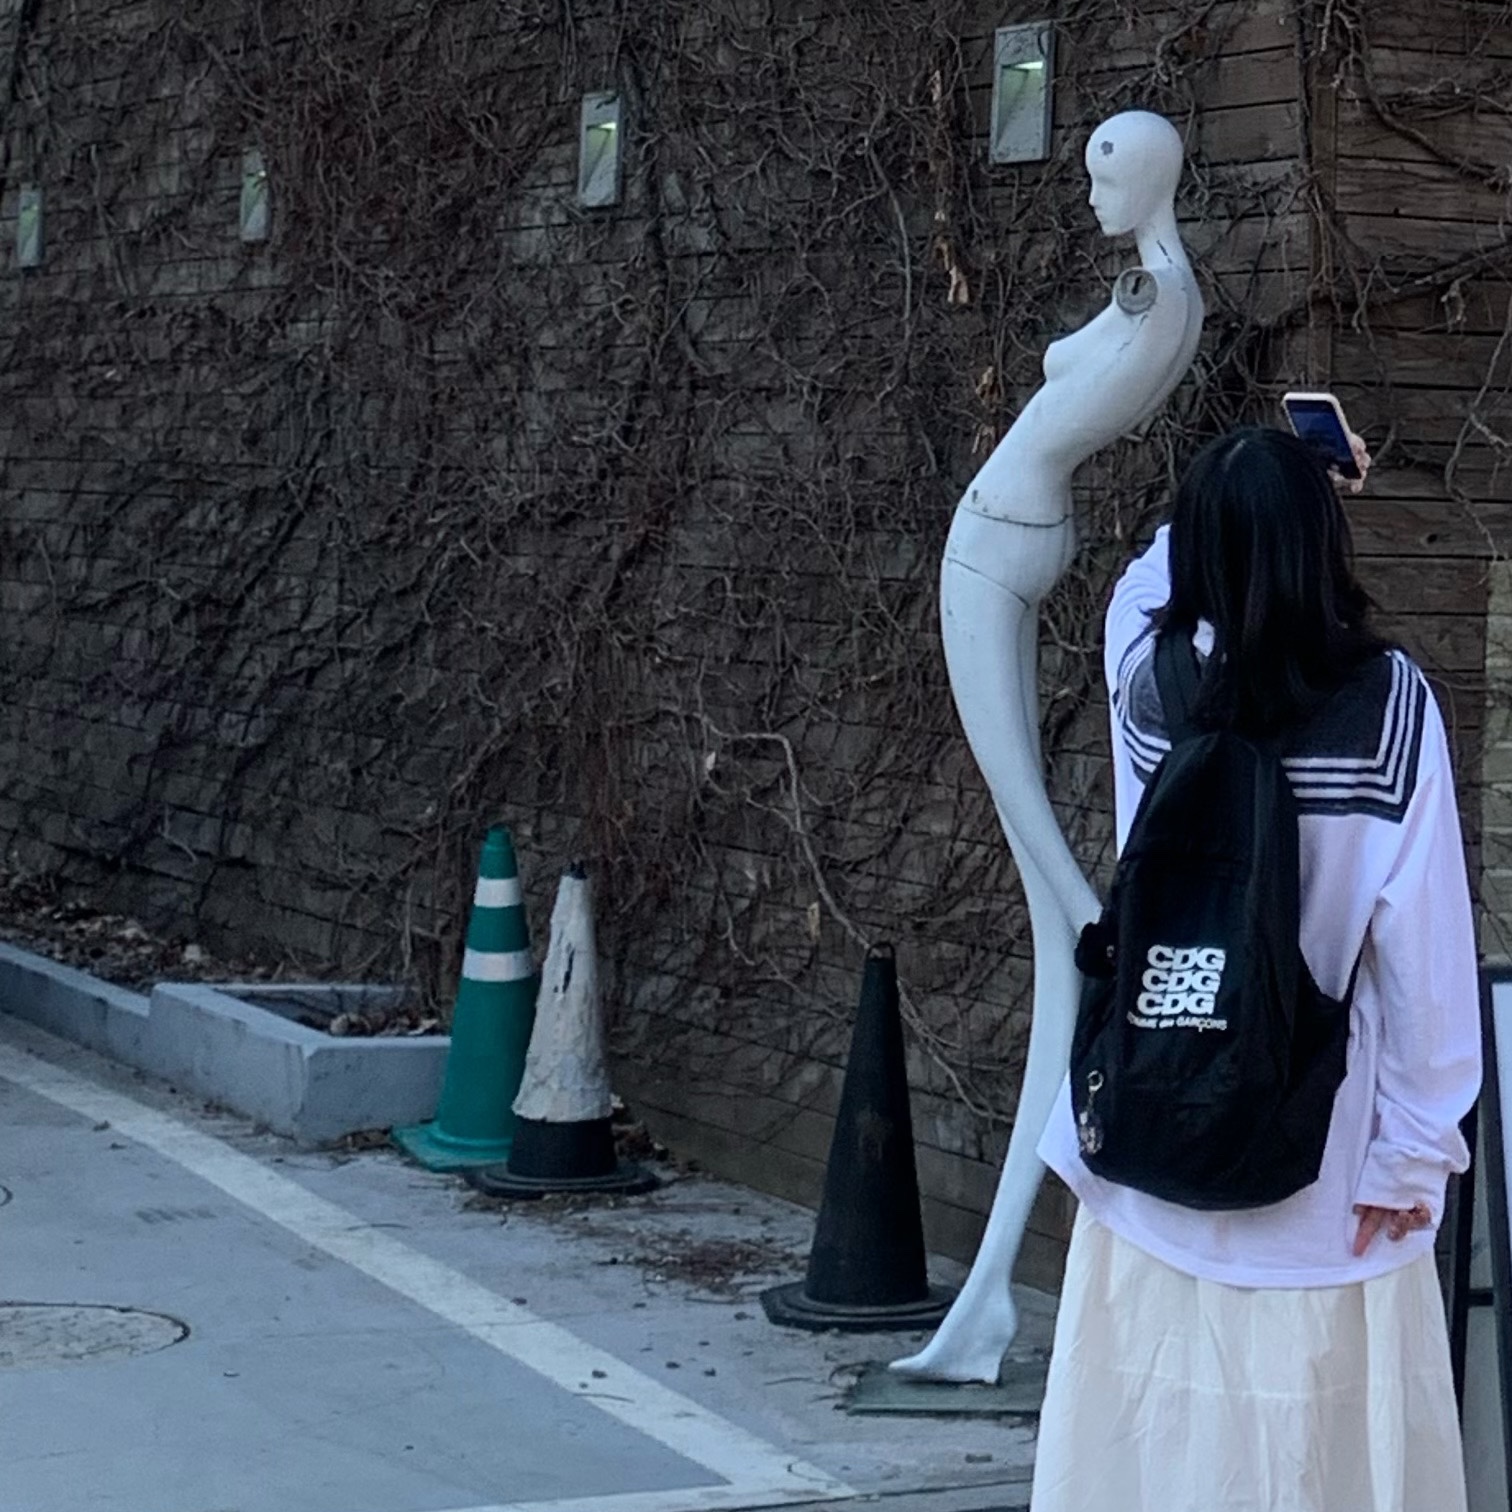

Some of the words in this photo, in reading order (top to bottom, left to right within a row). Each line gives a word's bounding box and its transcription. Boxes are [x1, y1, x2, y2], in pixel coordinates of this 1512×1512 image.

[1147, 944, 1226, 972] CDG
[1141, 968, 1221, 994] CDG
[1136, 991, 1216, 1016] CDG
